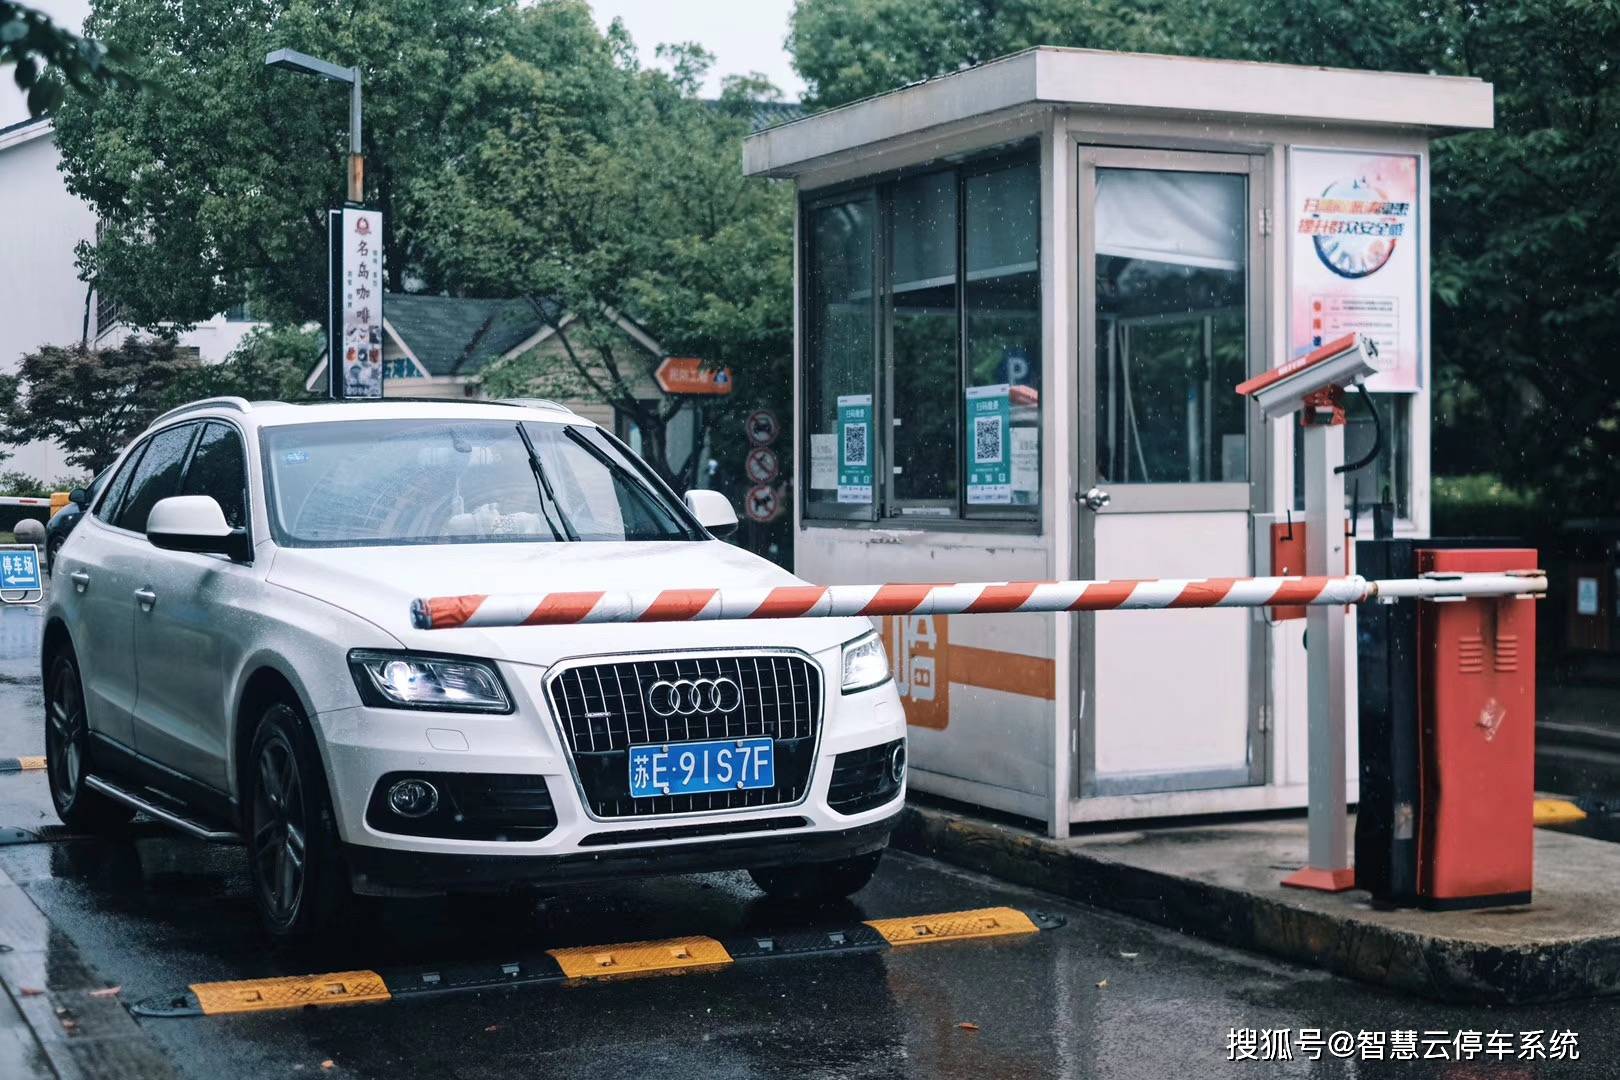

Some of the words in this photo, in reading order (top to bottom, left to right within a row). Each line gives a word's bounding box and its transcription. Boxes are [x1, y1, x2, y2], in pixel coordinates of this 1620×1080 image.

[356, 240, 370, 324] 名岛咖啡
[2, 555, 34, 576] 停车场
[633, 745, 770, 790] 苏E·91S7F
